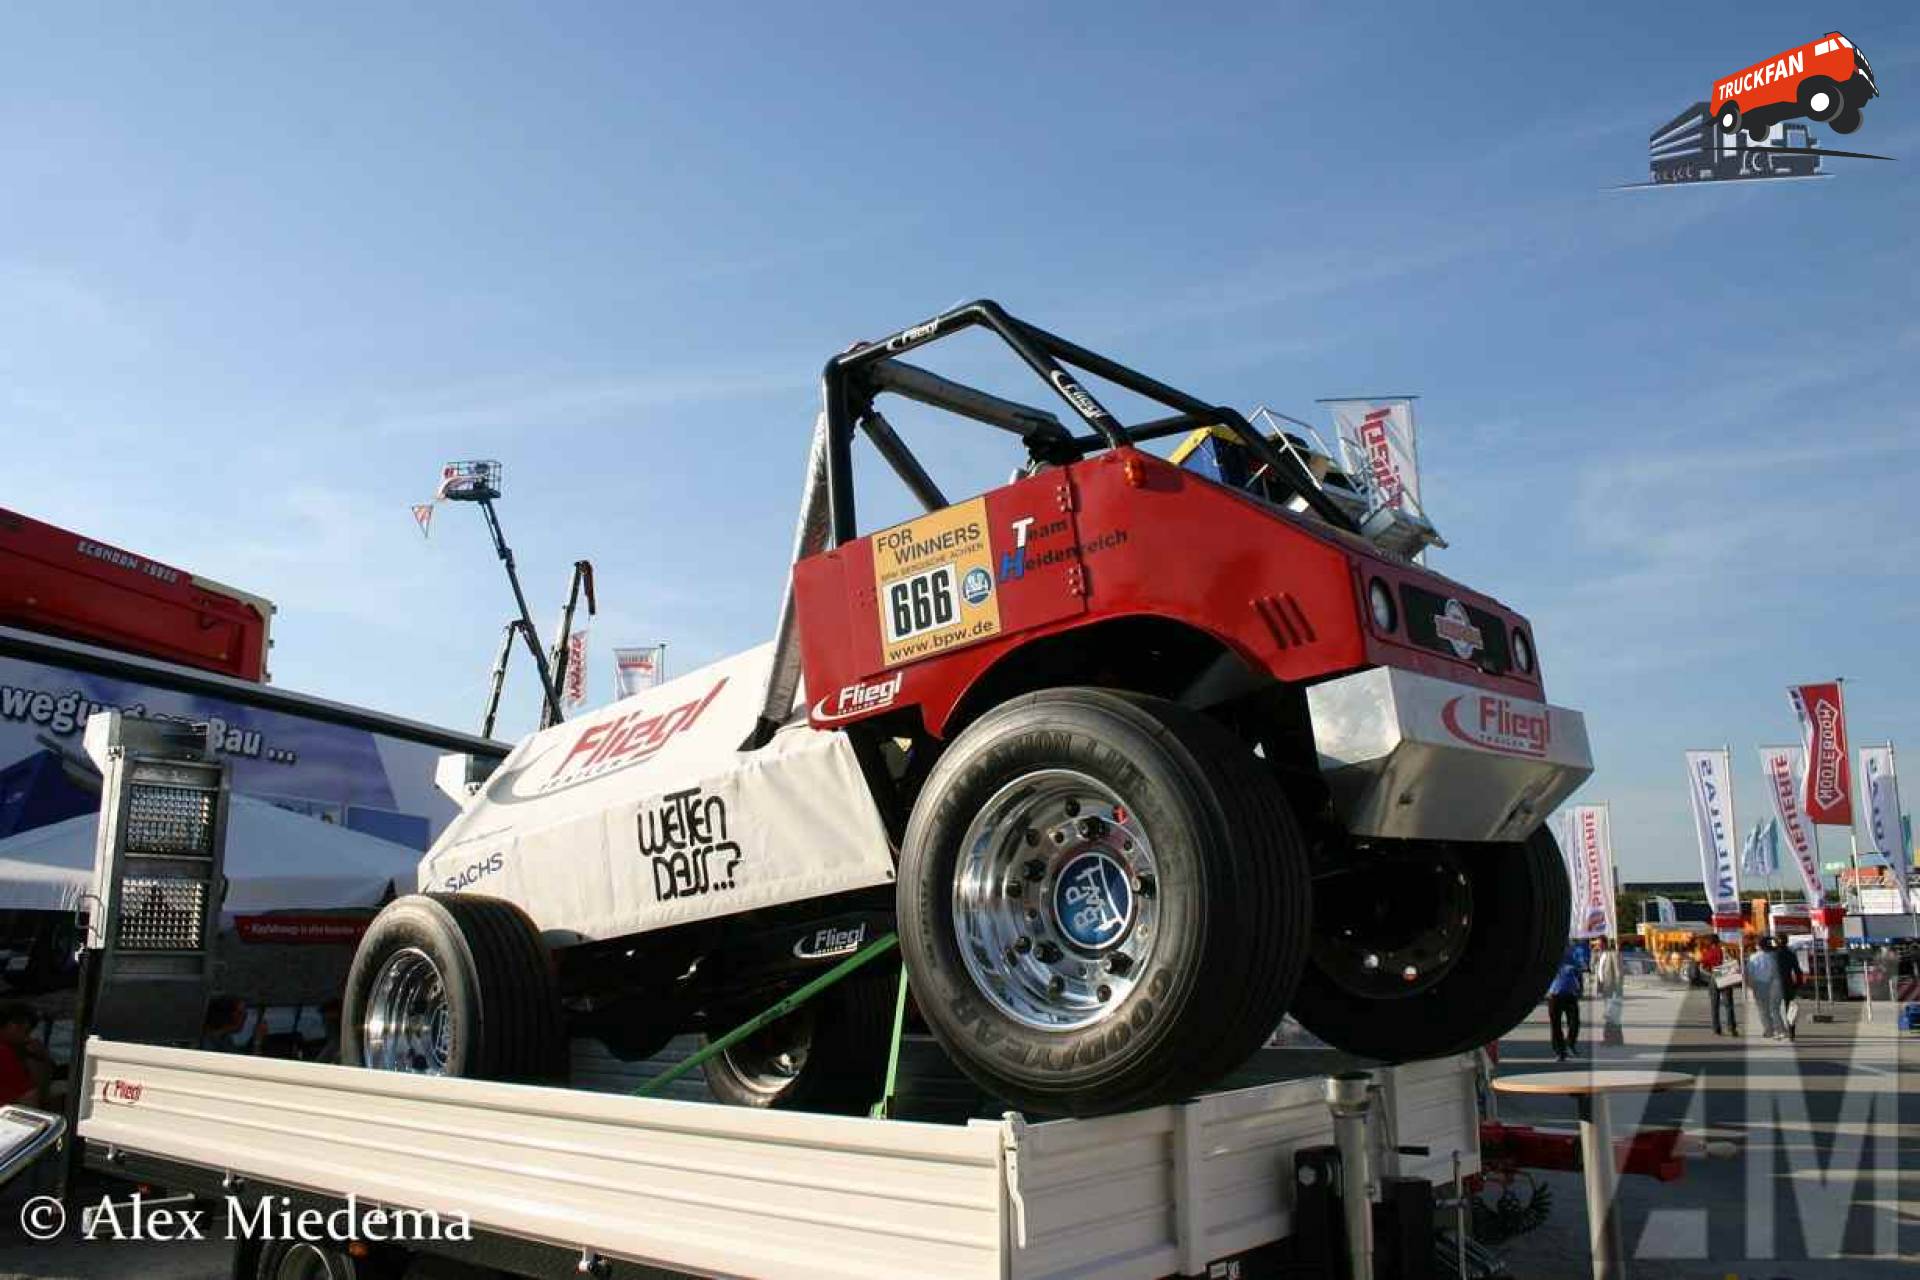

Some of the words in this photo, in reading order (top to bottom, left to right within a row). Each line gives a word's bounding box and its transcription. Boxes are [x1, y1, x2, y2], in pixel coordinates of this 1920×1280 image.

[901, 316, 939, 345] Fliegl
[1063, 381, 1109, 419] Fliegl
[877, 528, 912, 553] FOR
[894, 523, 981, 565] WINNERS
[1012, 516, 1068, 548] Team
[1000, 528, 1128, 583] Heidenreich
[891, 569, 953, 638] 666
[889, 620, 994, 661] www.bpw.de
[838, 671, 903, 709] Fliegl
[552, 676, 730, 778] Fliegl
[1480, 696, 1550, 751] Fliegl
[444, 852, 505, 894] SACHS
[815, 921, 866, 950] Fliegl
